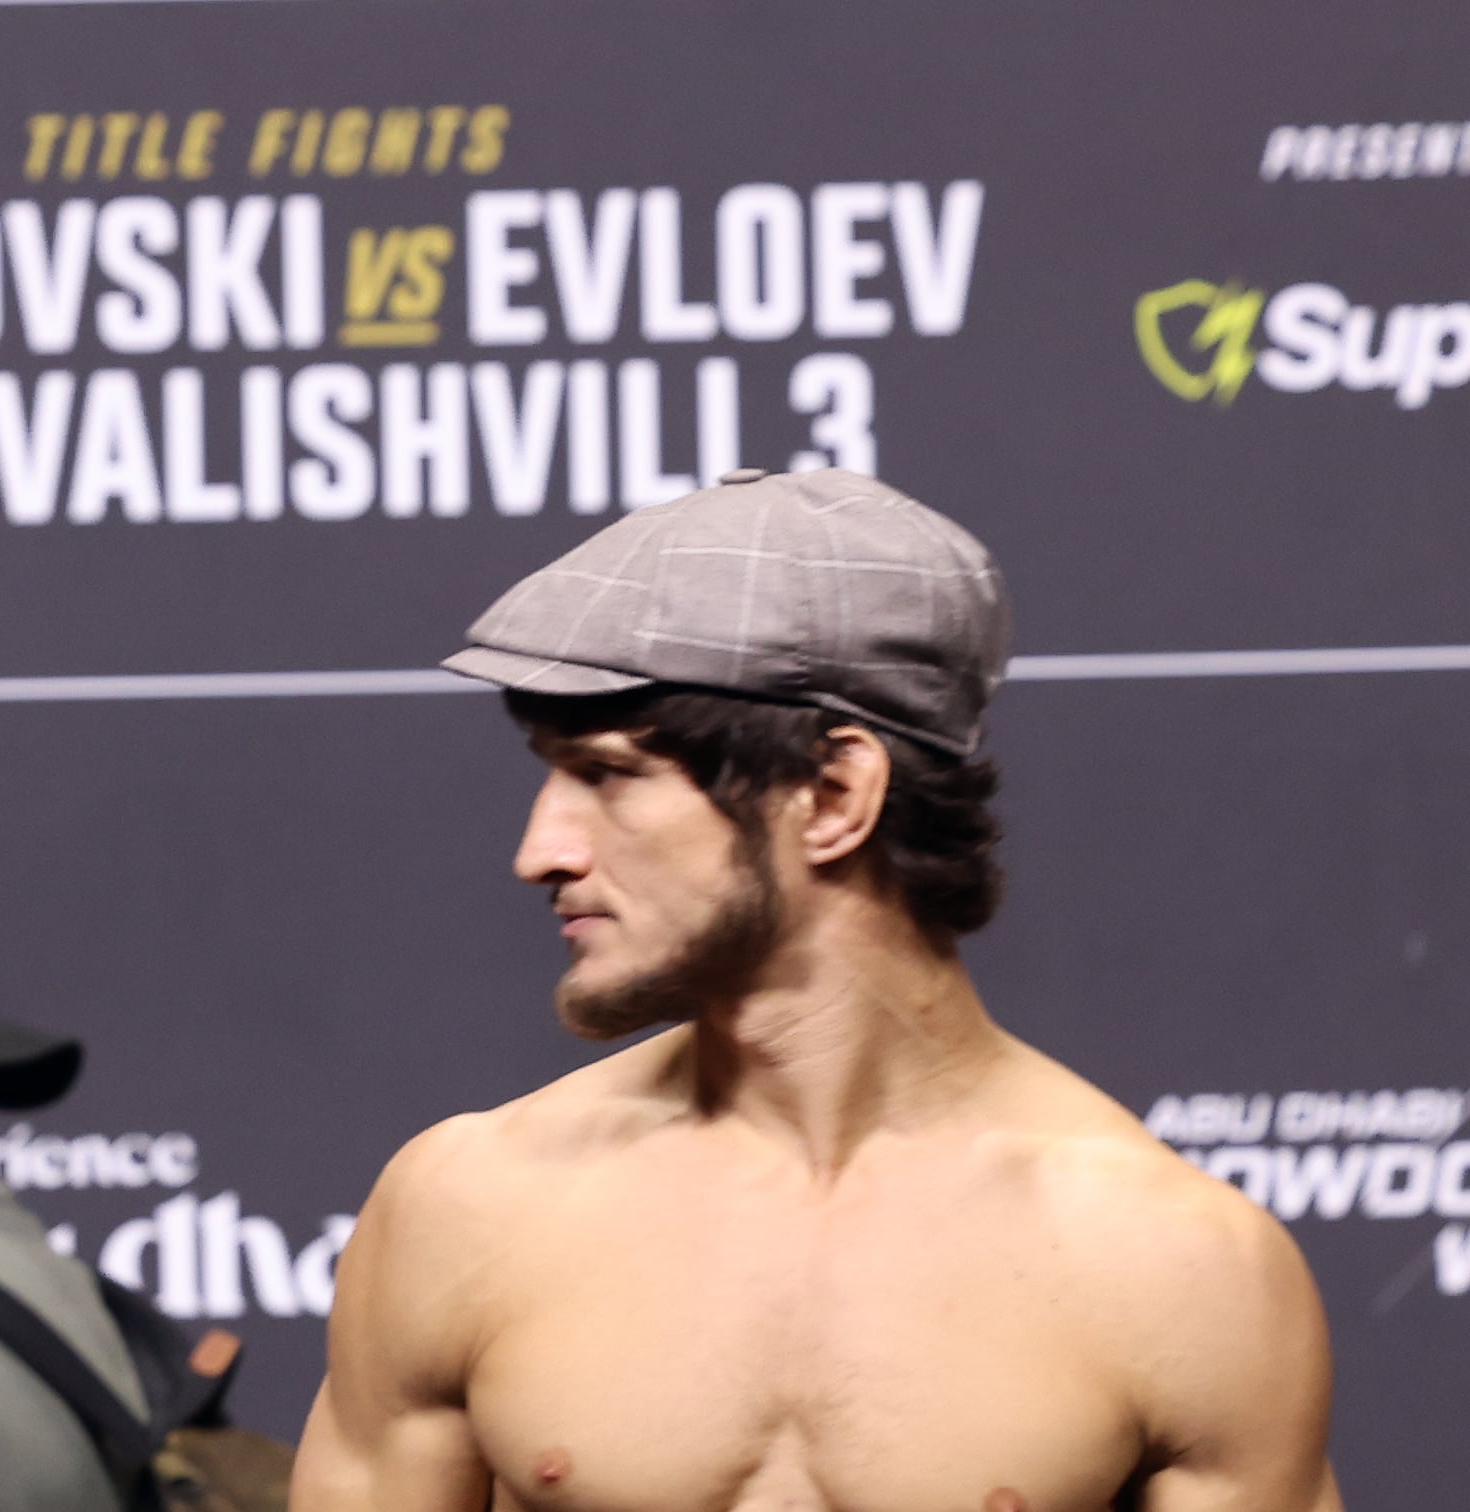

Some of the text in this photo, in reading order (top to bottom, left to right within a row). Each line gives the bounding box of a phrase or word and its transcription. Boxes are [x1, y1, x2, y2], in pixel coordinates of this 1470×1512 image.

[26, 111, 223, 181] TITLE
[250, 105, 510, 177] FIGHTS
[1263, 124, 1470, 180] PRESEN
[466, 181, 984, 345] EVLOEV
[788, 353, 876, 478] 3
